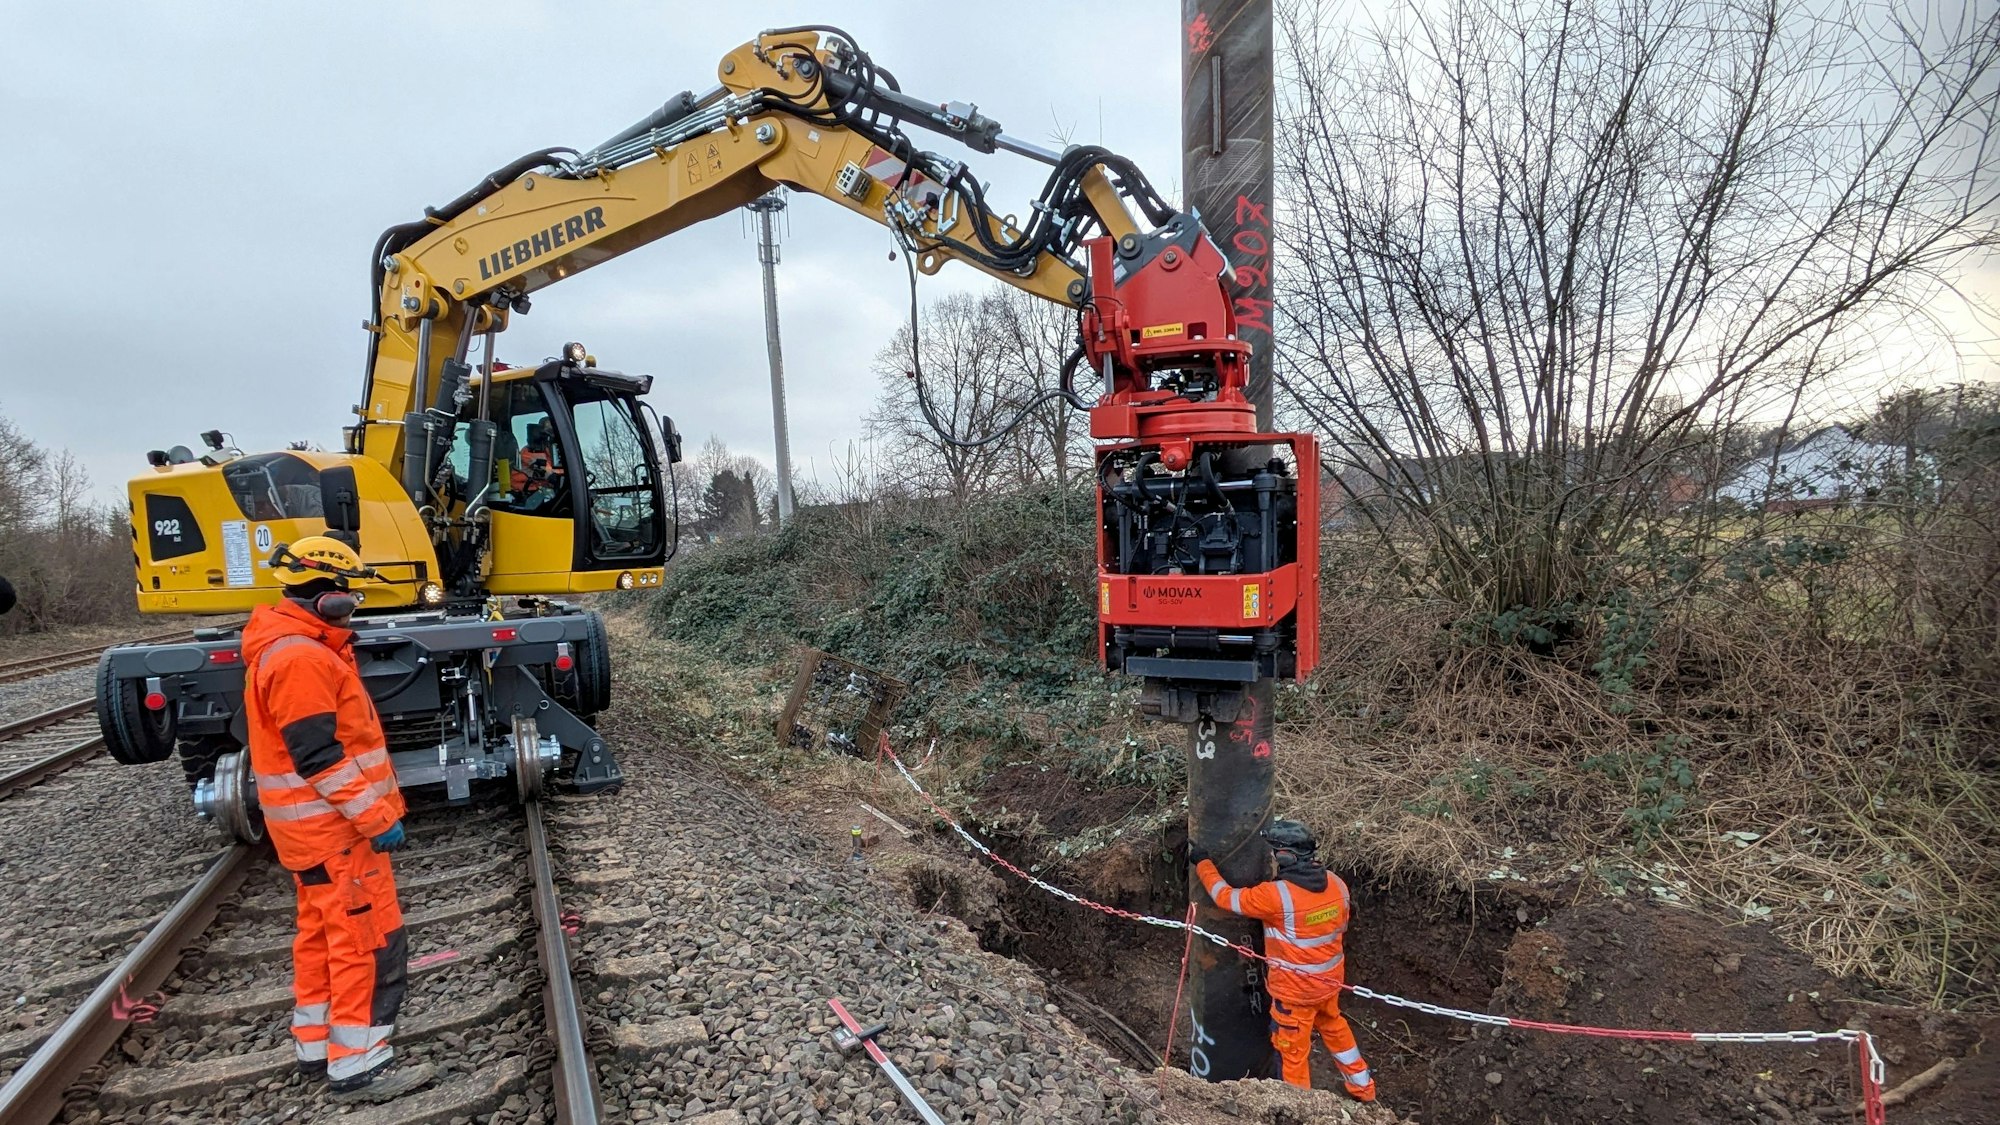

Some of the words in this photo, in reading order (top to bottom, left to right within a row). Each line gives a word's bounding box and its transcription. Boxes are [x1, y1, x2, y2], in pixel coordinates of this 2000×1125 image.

[478, 206, 608, 281] LIEBHERR
[1232, 195, 1273, 334] M207
[155, 519, 181, 536] 922
[257, 529, 270, 547] 20
[1158, 587, 1202, 598] MOVAX
